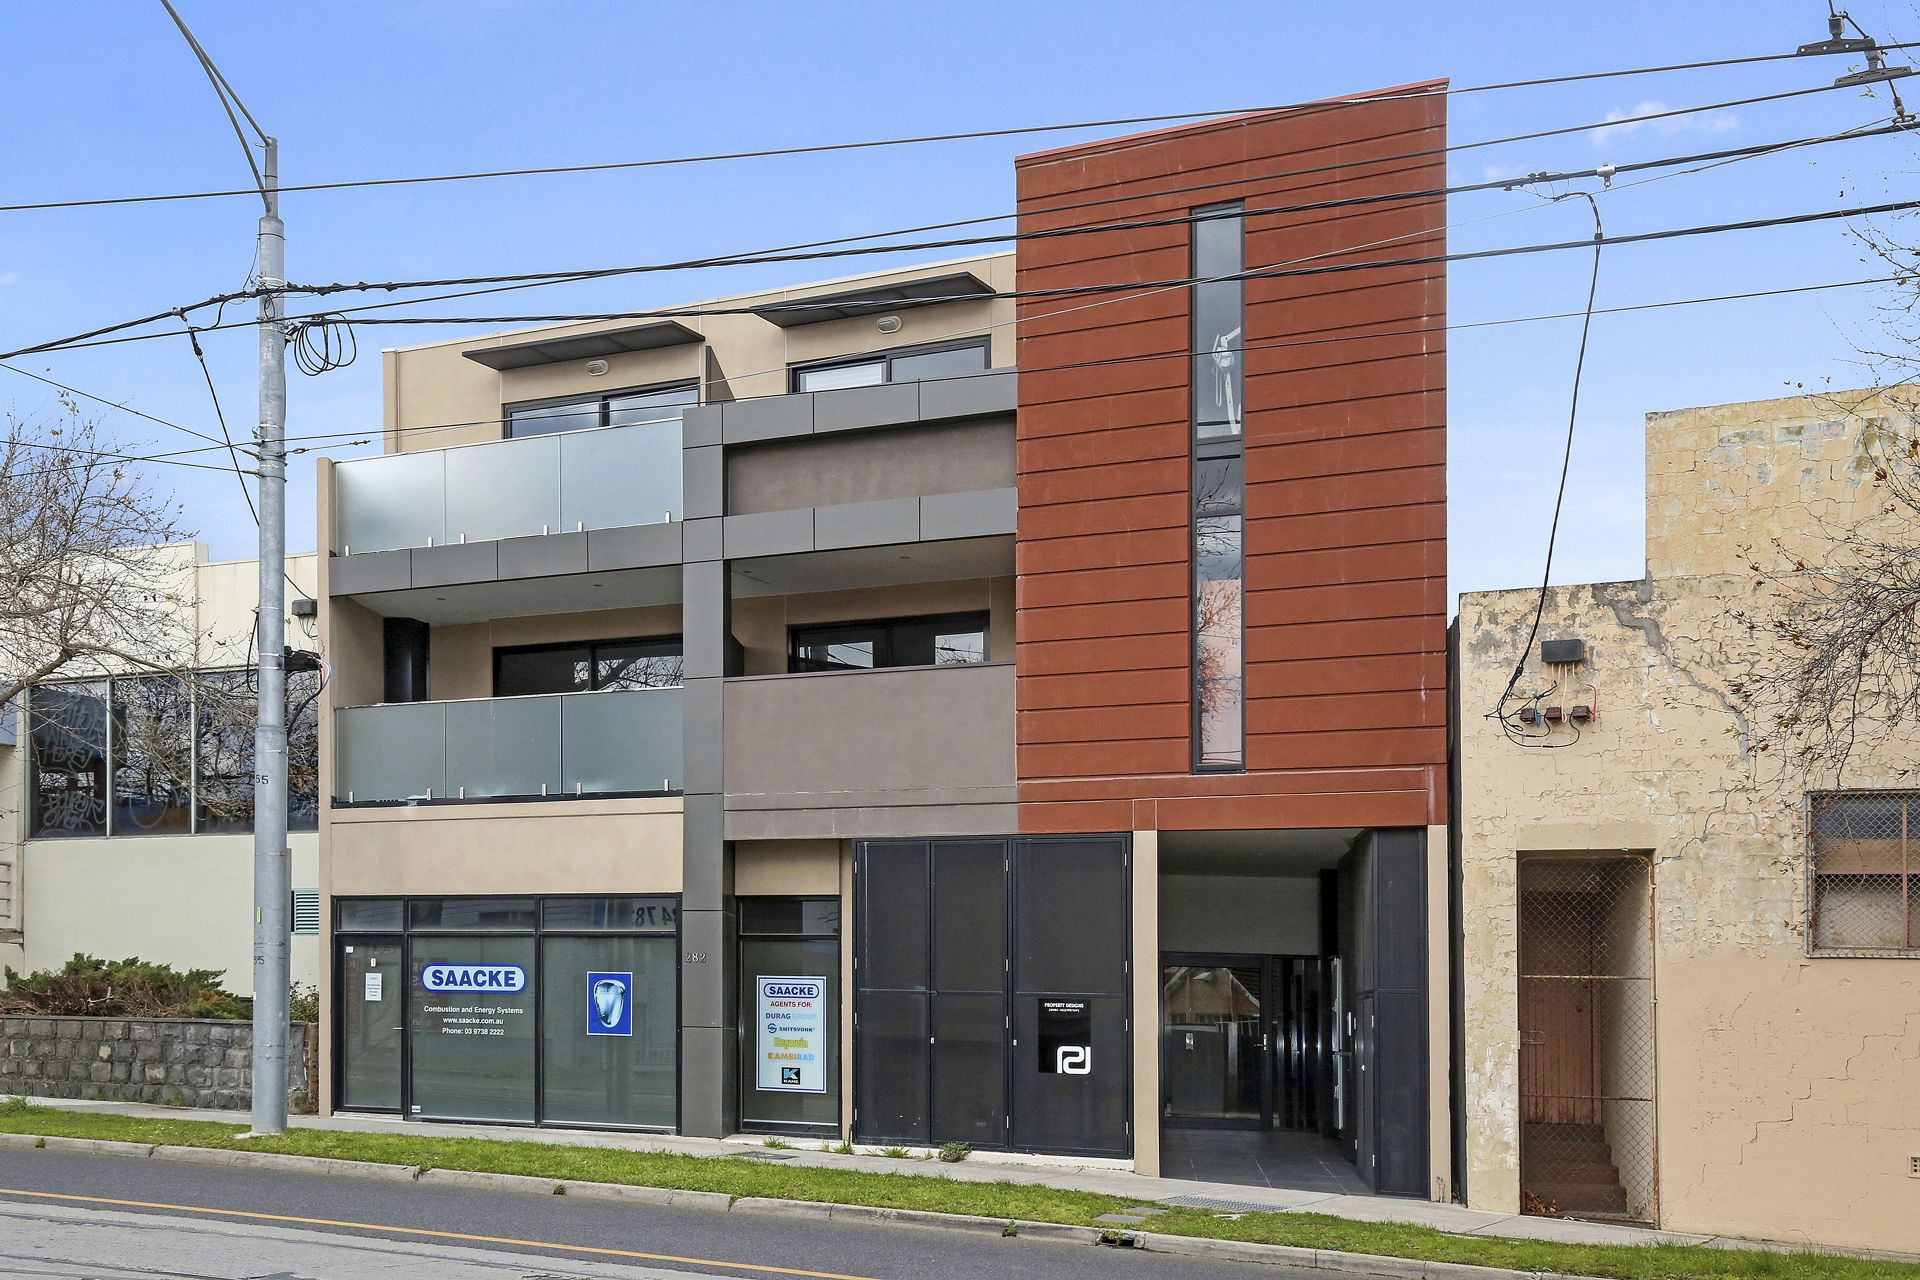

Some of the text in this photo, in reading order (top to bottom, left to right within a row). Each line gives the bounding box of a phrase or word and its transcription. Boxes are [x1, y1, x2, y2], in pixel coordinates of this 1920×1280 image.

[685, 952, 707, 963] 282
[431, 969, 516, 988] SAACKE
[769, 986, 814, 996] SAACKE
[423, 1005, 461, 1013] Combustion
[474, 1006, 496, 1015] Energy
[496, 1006, 524, 1015] Systems
[442, 1017, 504, 1025] www.saacke.com.au
[765, 1012, 791, 1020] DURAG
[442, 1027, 464, 1035] Phone:
[473, 1028, 489, 1036] 9738
[489, 1028, 505, 1036] 2222
